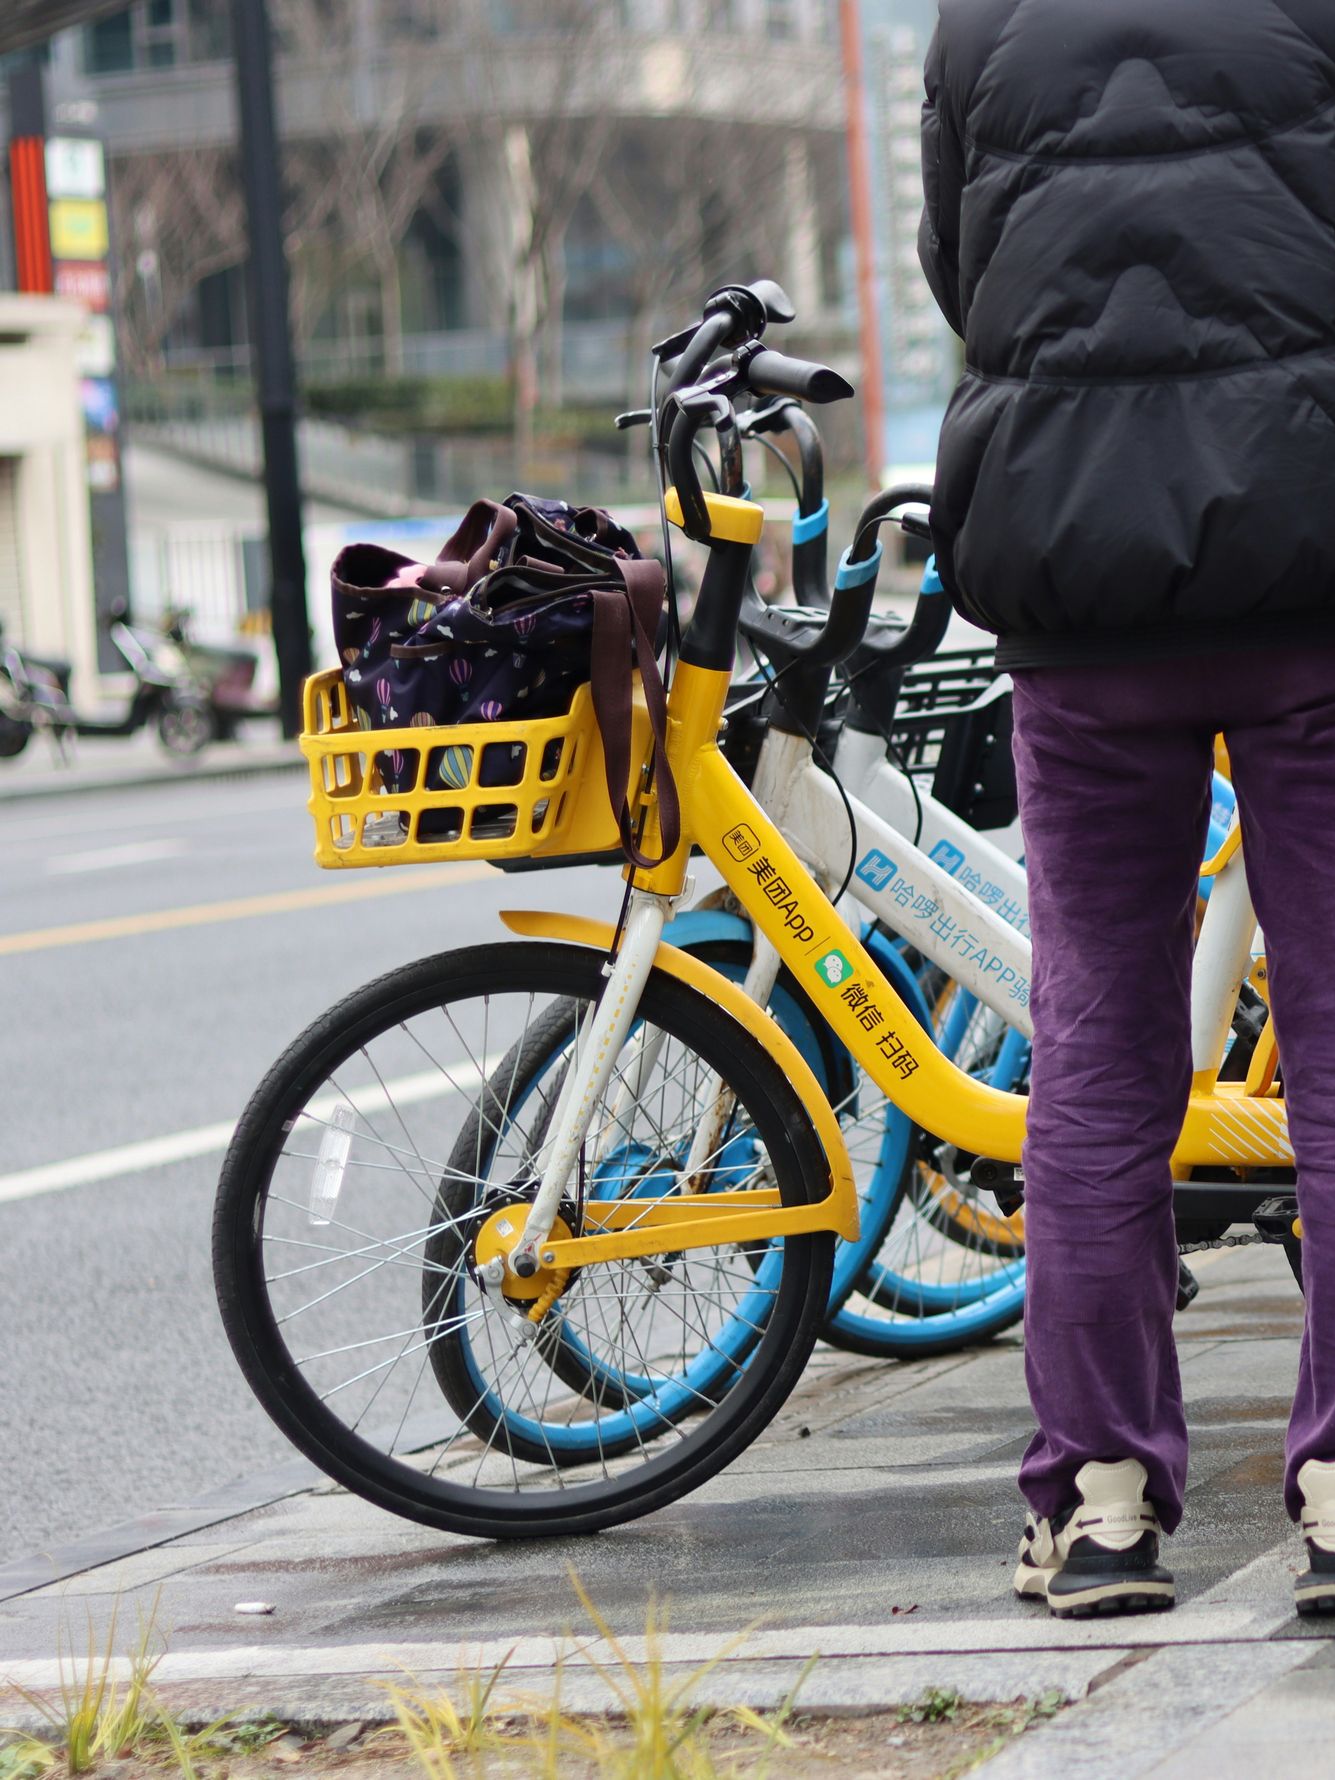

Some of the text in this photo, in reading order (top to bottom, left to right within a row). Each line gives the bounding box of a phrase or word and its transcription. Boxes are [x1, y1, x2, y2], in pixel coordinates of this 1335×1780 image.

[747, 856, 814, 942] 美团App
[841, 983, 919, 1080] 微信 扫码
